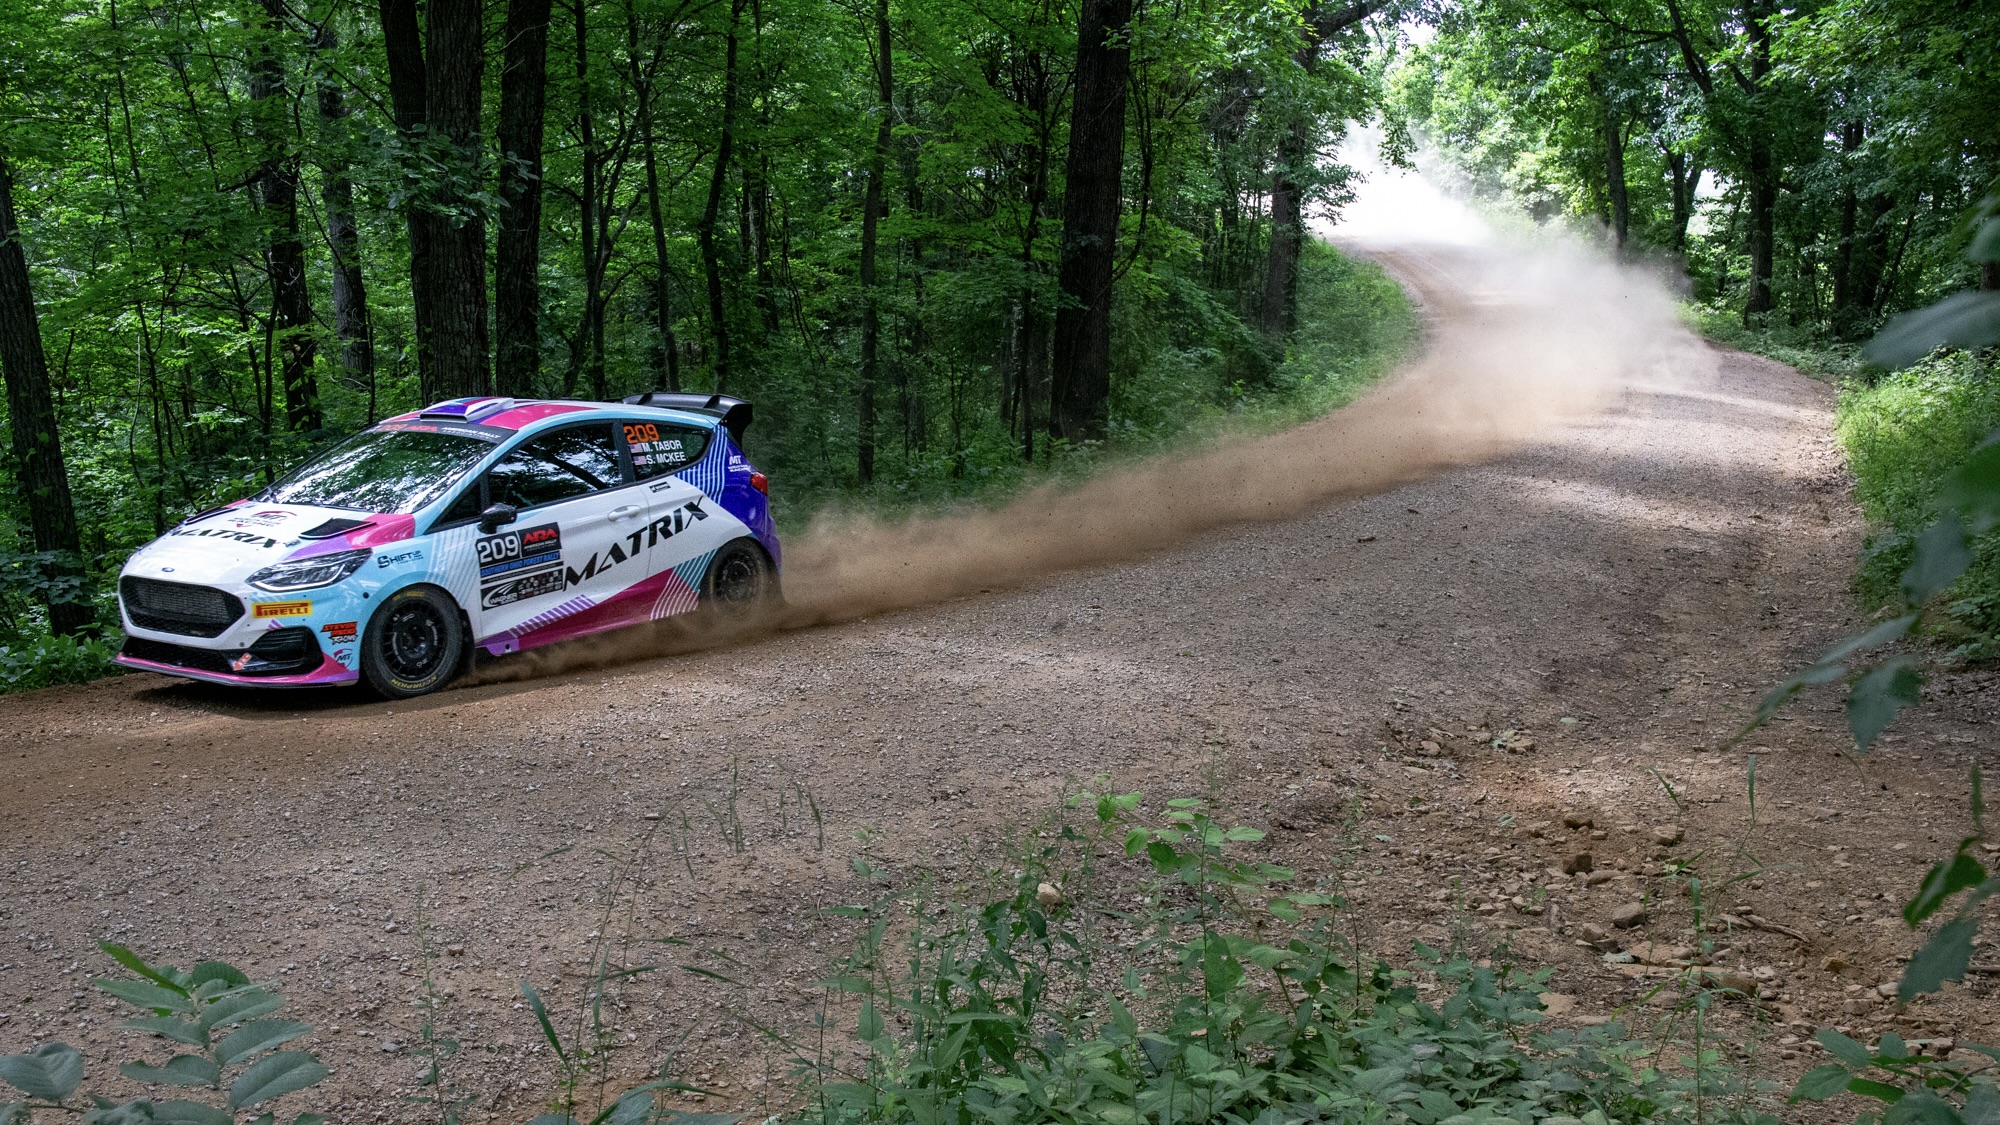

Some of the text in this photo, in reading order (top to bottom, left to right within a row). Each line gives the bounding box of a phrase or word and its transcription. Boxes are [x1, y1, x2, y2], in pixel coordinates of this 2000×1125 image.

[623, 423, 660, 444] 209
[642, 439, 683, 452] M. TABOR
[646, 451, 687, 465] S. MCKEE
[523, 528, 558, 545] ARA
[562, 495, 709, 592] MATRIX
[477, 535, 519, 564] 209
[480, 563, 510, 577] SOUTHERN
[509, 560, 523, 570] OHIO
[523, 556, 543, 567] FOREST
[543, 551, 559, 561] RALLY
[255, 602, 309, 617] PIRELLI
[391, 675, 437, 689] SCORPION
